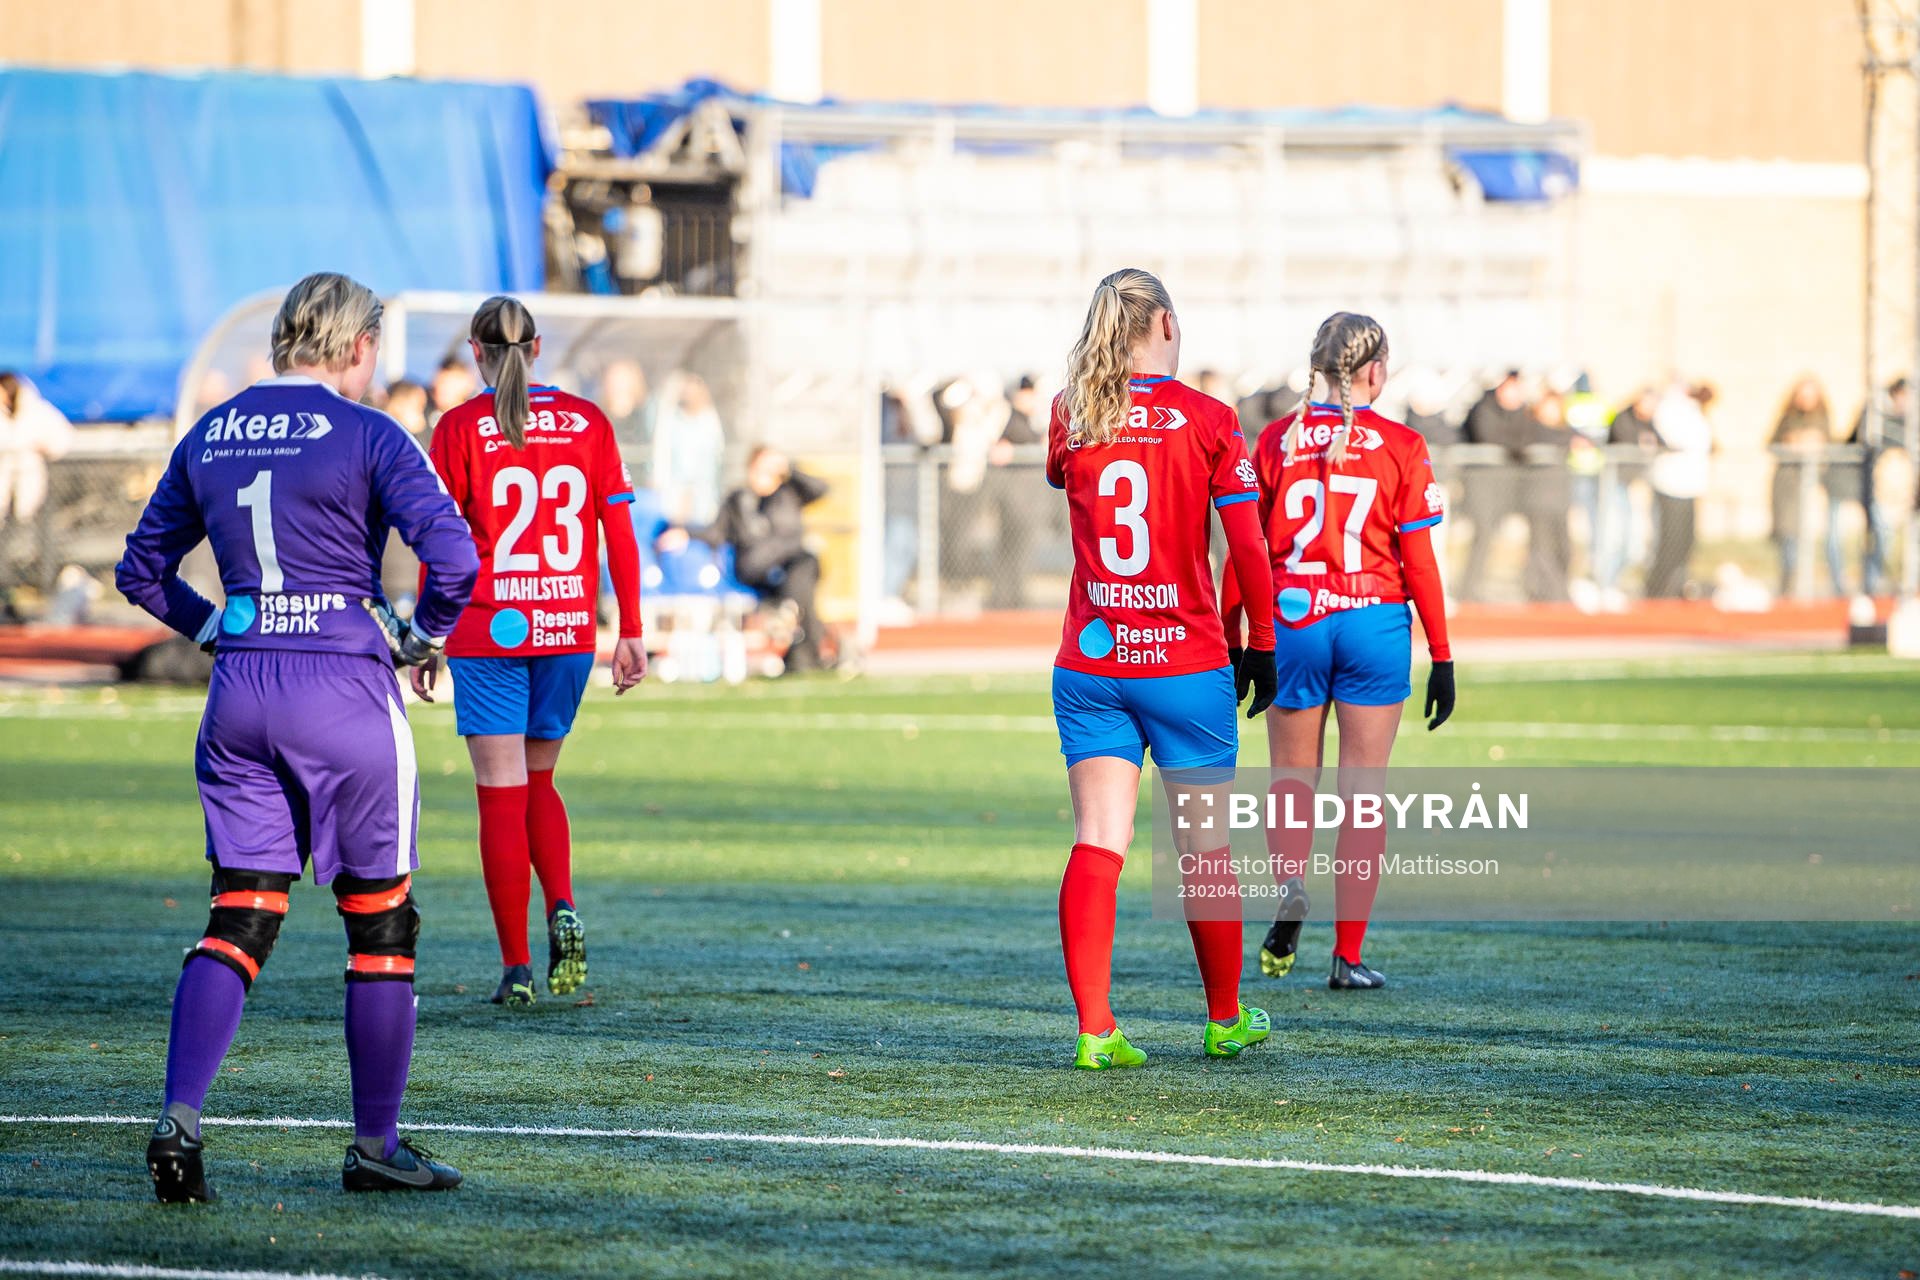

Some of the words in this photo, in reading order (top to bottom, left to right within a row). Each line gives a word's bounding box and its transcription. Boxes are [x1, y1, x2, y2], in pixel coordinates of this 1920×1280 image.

[205, 408, 290, 442] akea
[477, 409, 557, 437] aea
[1113, 435, 1137, 443] ELEDA
[1138, 436, 1163, 445] GROUP
[236, 470, 284, 593] 1
[492, 464, 588, 573] 23
[1098, 459, 1150, 577] 3
[1285, 474, 1378, 575] 27
[493, 575, 585, 602] WAHLSTEDT
[1087, 580, 1179, 610] ANDERSSON
[260, 611, 320, 635] Bank
[532, 609, 589, 629] Resurs
[532, 626, 577, 647] Bank
[1116, 624, 1187, 644] Resurs
[1117, 644, 1169, 665] Bank
